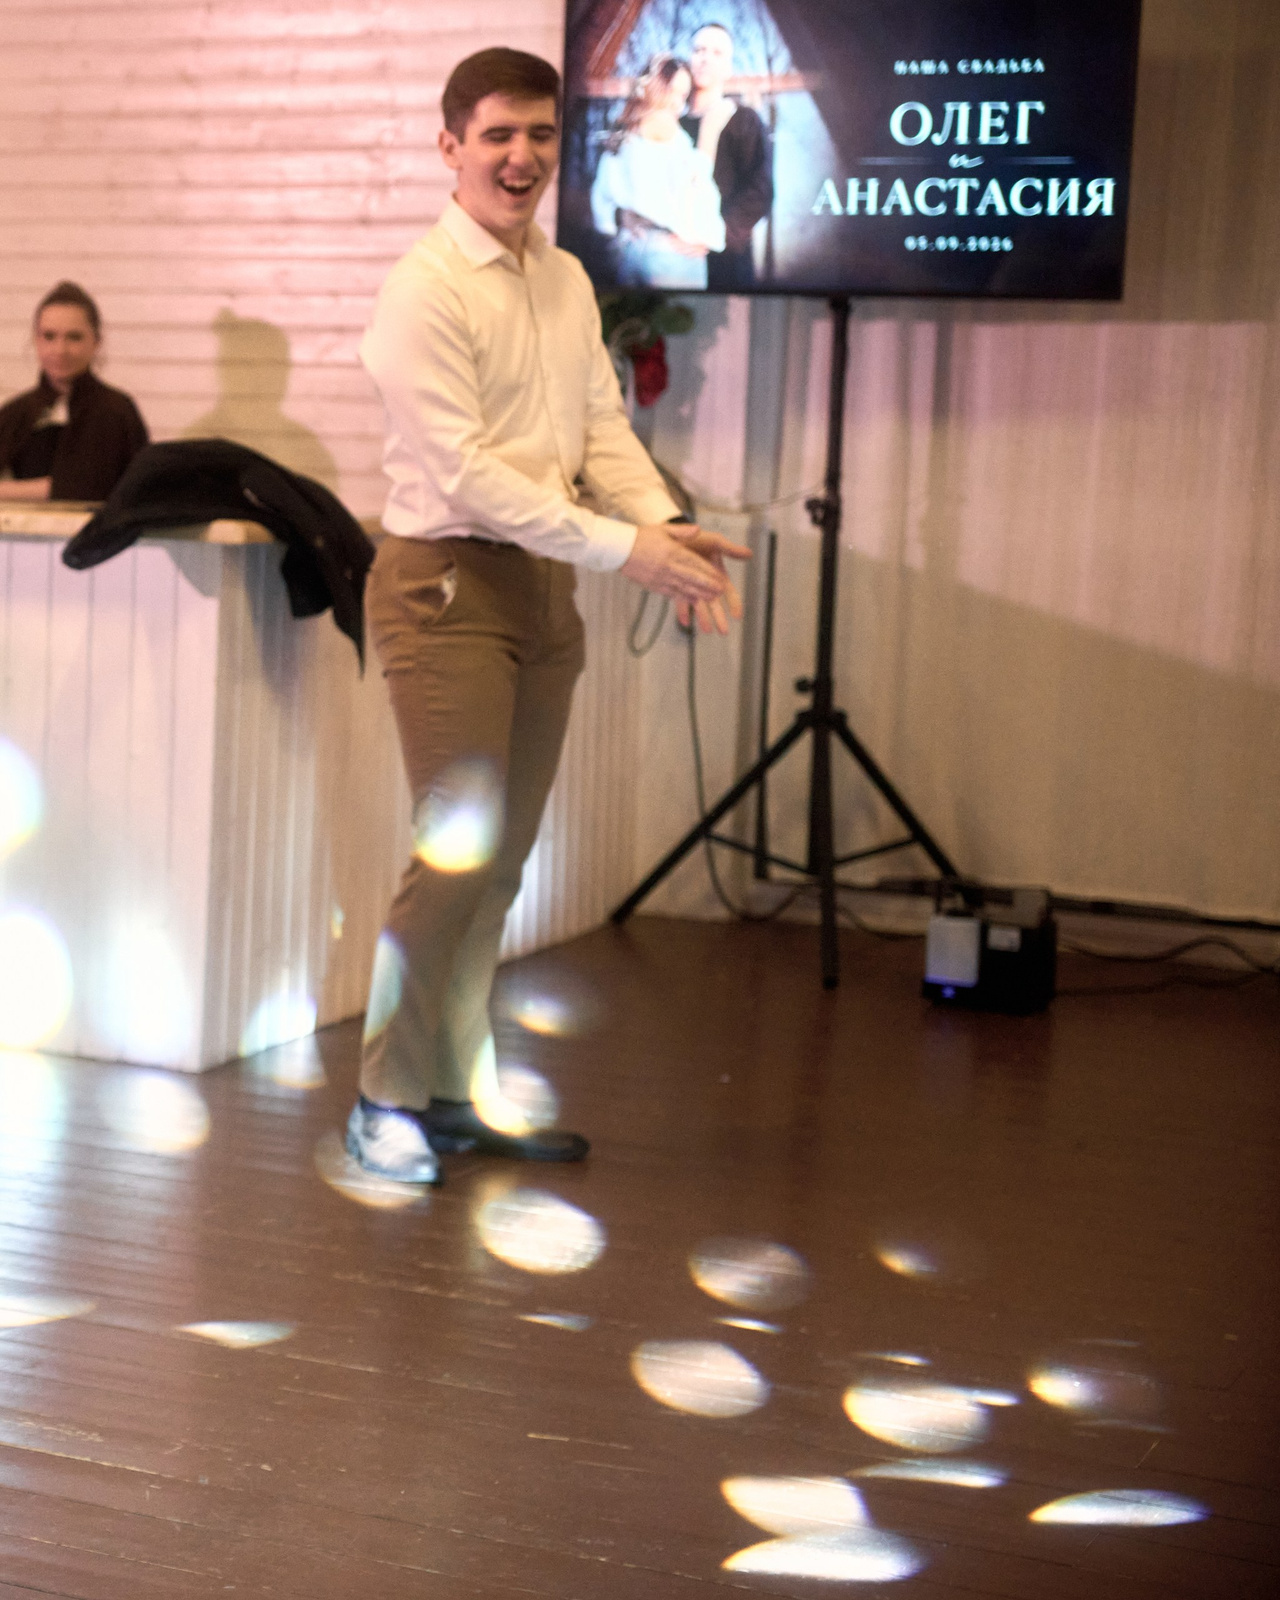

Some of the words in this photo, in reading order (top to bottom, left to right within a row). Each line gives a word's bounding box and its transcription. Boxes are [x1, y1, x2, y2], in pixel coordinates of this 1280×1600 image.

[893, 59, 950, 76] НАША
[956, 57, 1046, 75] СВАДЬБА
[889, 100, 1046, 147] ОЛЕГ
[811, 177, 1116, 217] АНАСТАСИЯ
